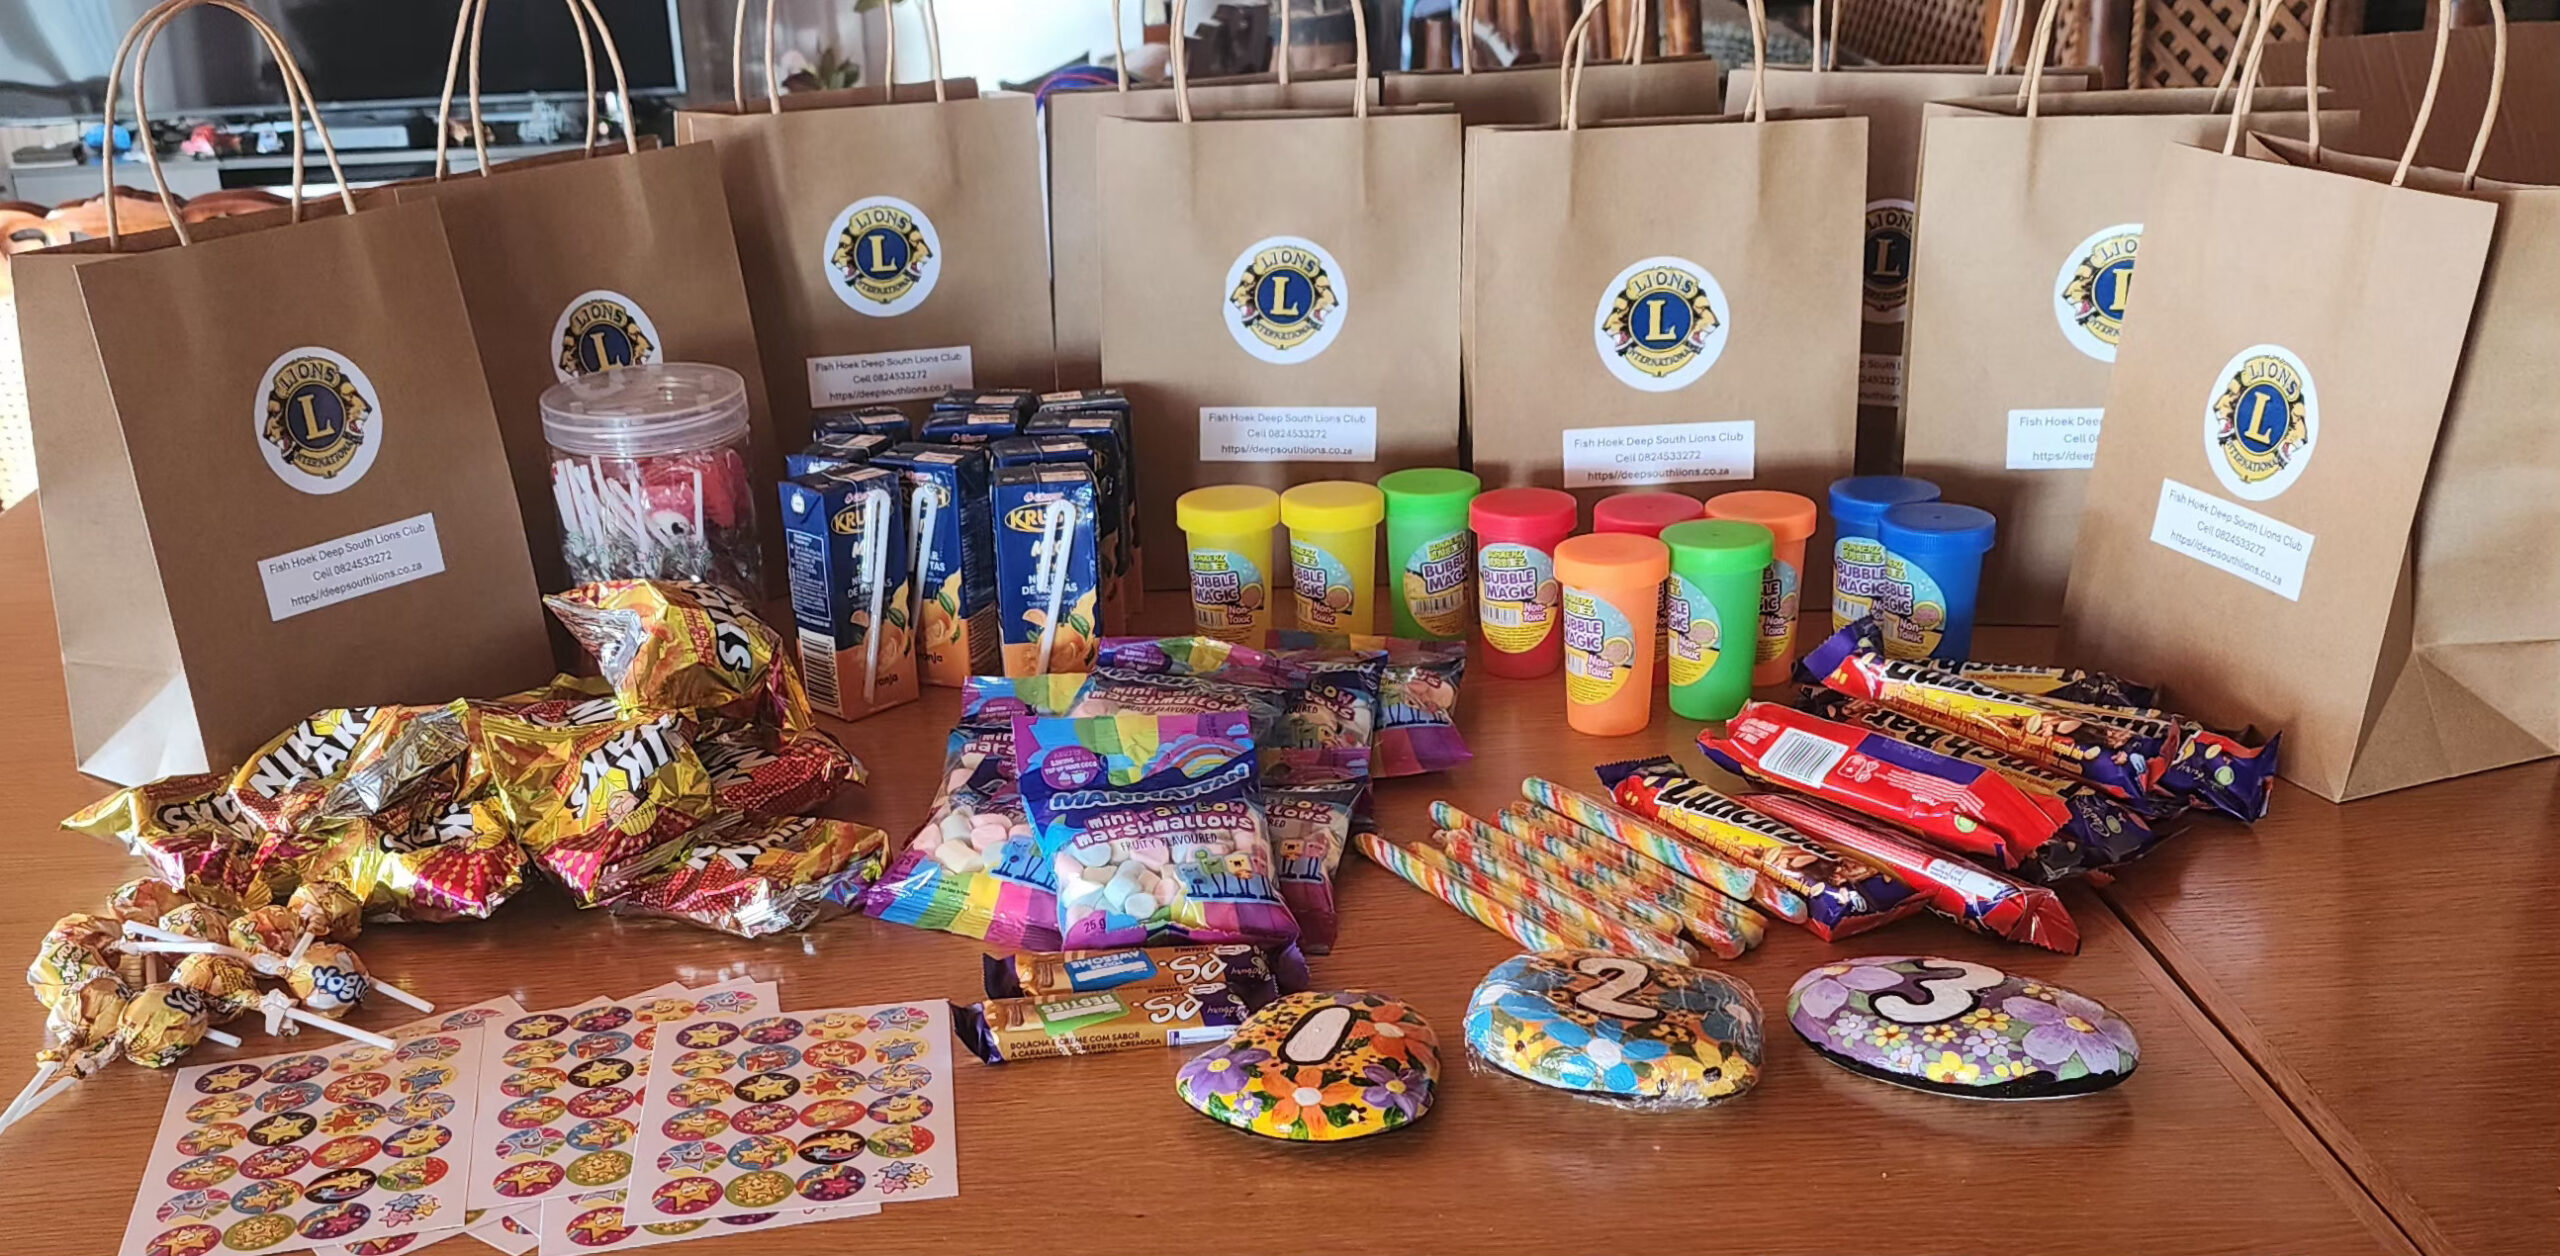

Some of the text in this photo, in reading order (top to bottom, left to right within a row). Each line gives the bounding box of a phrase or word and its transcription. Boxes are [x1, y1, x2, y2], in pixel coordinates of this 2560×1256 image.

[856, 211, 908, 229] LIONS
[1867, 212, 1912, 232] LION
[868, 235, 897, 272] L
[2101, 240, 2137, 260] LIO
[1262, 251, 1315, 273] LIONS
[1633, 272, 1694, 293] LIONS
[1270, 277, 1299, 316] L
[576, 304, 624, 325] LIONS
[1645, 300, 1677, 340] L
[815, 363, 834, 372] Fish
[862, 360, 885, 368] Deep
[887, 358, 912, 366] South
[915, 355, 939, 364] Lions
[941, 353, 961, 362] Club
[280, 364, 334, 389] LIONS
[853, 375, 870, 384] Cell
[2250, 362, 2298, 395] LIONS
[297, 394, 336, 440] L
[1209, 413, 1366, 424] Fish Hoek Deep South Lions Club
[2020, 417, 2098, 426] Fish Hoek Dee
[2244, 392, 2272, 445] L
[1248, 429, 1266, 438] Cell
[1575, 432, 1743, 448] Fish Hoek Deep South Lions Club
[2064, 434, 2086, 443] Cell
[1616, 451, 1701, 463] Cell 0824533272
[834, 509, 866, 532] KRU
[2169, 489, 2302, 552] Fish Hoek Deep South Lions Club
[2198, 521, 2266, 556] Cell 0824533272
[269, 524, 425, 574] Fish Hoek Deep South Lions Club
[313, 551, 392, 581] Cell 0824533272
[1193, 574, 1236, 587] BUBBLE
[1484, 570, 1534, 584] BUBBLE
[1195, 588, 1238, 601] MAGIC
[1296, 581, 1324, 596] AGIC
[1487, 585, 1534, 599] MAGIC
[981, 733, 1015, 741] min
[249, 719, 325, 799] NIK
[1050, 762, 1249, 810] MANHATTAN
[1088, 811, 1134, 829] mini
[1138, 802, 1245, 821] rainbow
[1075, 815, 1254, 848] marshmallows
[1161, 833, 1217, 847] FLAVOURED
[1084, 919, 1106, 933] 25 g
[1071, 951, 1140, 969] AWESOME
[312, 966, 369, 1003] Yogu
[1574, 956, 1665, 1023] 2
[1869, 959, 2006, 1024] 3
[1042, 994, 1116, 1014] BESTIES
[1009, 1040, 1050, 1050] BOLACHA
[1090, 1034, 1110, 1042] COM
[1112, 1031, 1140, 1041] SABOR
[1120, 1038, 1161, 1049] CREMOSA
